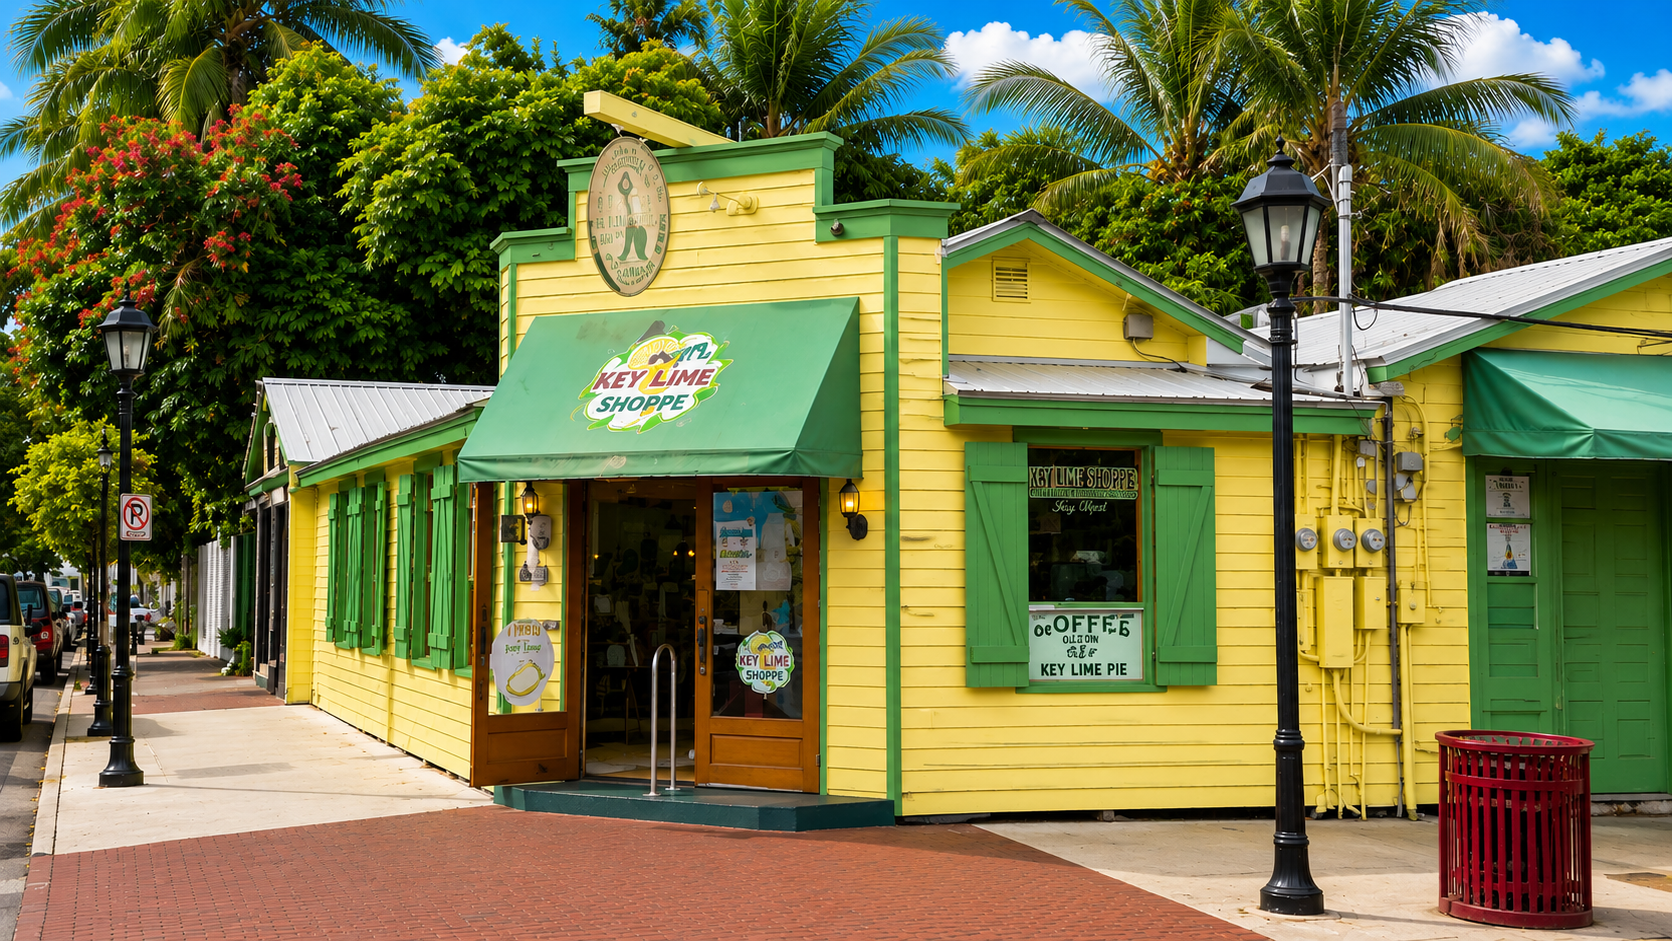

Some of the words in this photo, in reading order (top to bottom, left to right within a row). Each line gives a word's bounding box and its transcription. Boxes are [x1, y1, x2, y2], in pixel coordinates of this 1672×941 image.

[592, 370, 648, 390] KEY
[649, 368, 716, 387] LIME
[596, 394, 690, 413] SHOPPE
[1055, 467, 1085, 488] LIME
[1086, 467, 1136, 490] SHOPPE
[740, 654, 759, 666] KEY
[764, 655, 790, 667] LIME
[746, 670, 784, 681] SHOPPE
[1040, 662, 1066, 677] KEY
[1071, 662, 1102, 676] LIME
[1107, 662, 1127, 676] PIE
